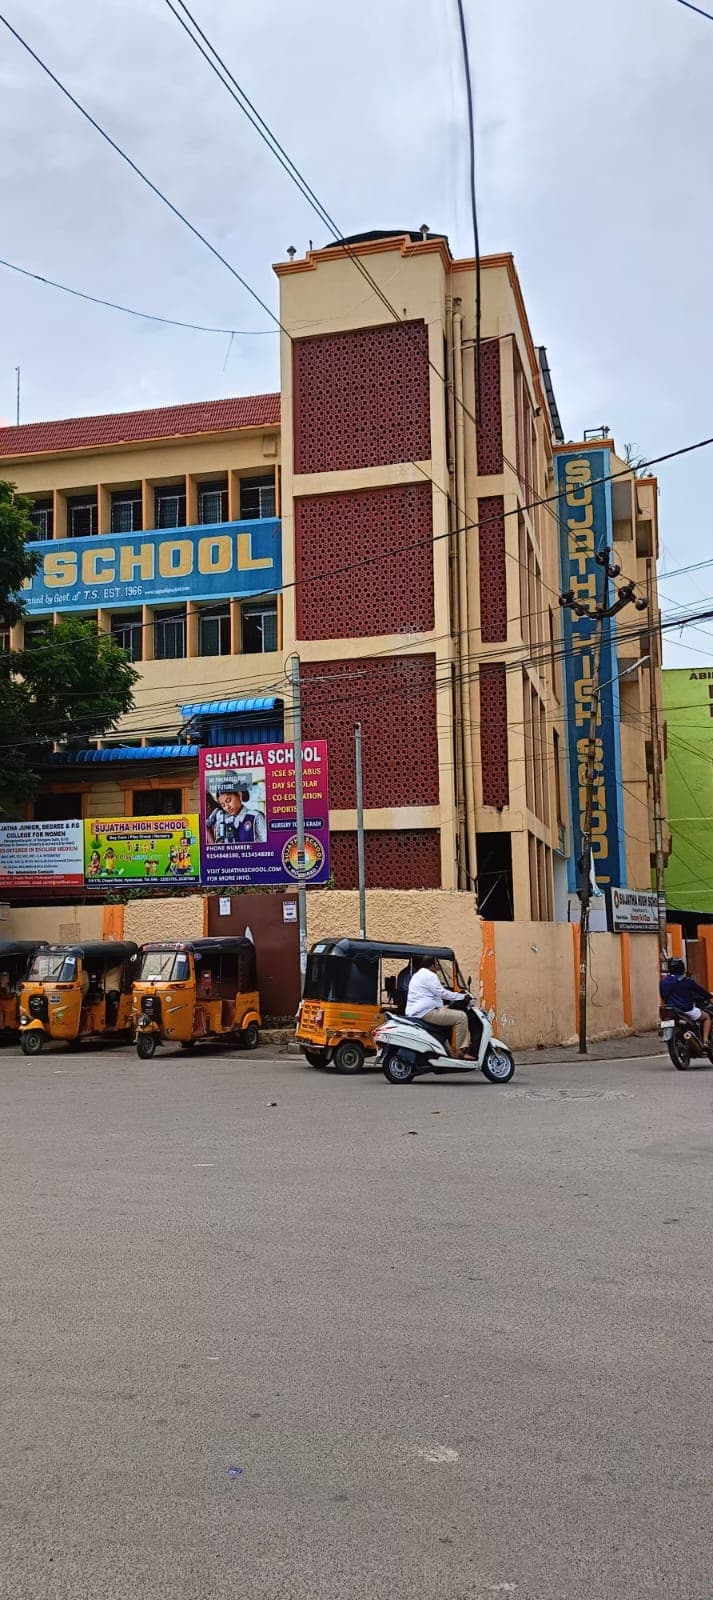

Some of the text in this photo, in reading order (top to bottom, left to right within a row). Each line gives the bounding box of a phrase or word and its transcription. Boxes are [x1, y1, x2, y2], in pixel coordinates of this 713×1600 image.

[44, 533, 273, 588] SCHOOL
[54, 592, 70, 603] Govt.
[84, 590, 100, 600] T.S.
[104, 588, 123, 598] EST.
[125, 586, 142, 597] 1966
[689, 672, 713, 680] ABI
[205, 747, 321, 768] SUJATHA SCHOL
[272, 768, 321, 777] ICSE SYABUS
[272, 793, 322, 802] CO-EDUATION
[96, 821, 186, 832] SUJATHA HIGH SCHOOL
[285, 838, 297, 863] SUJATH
